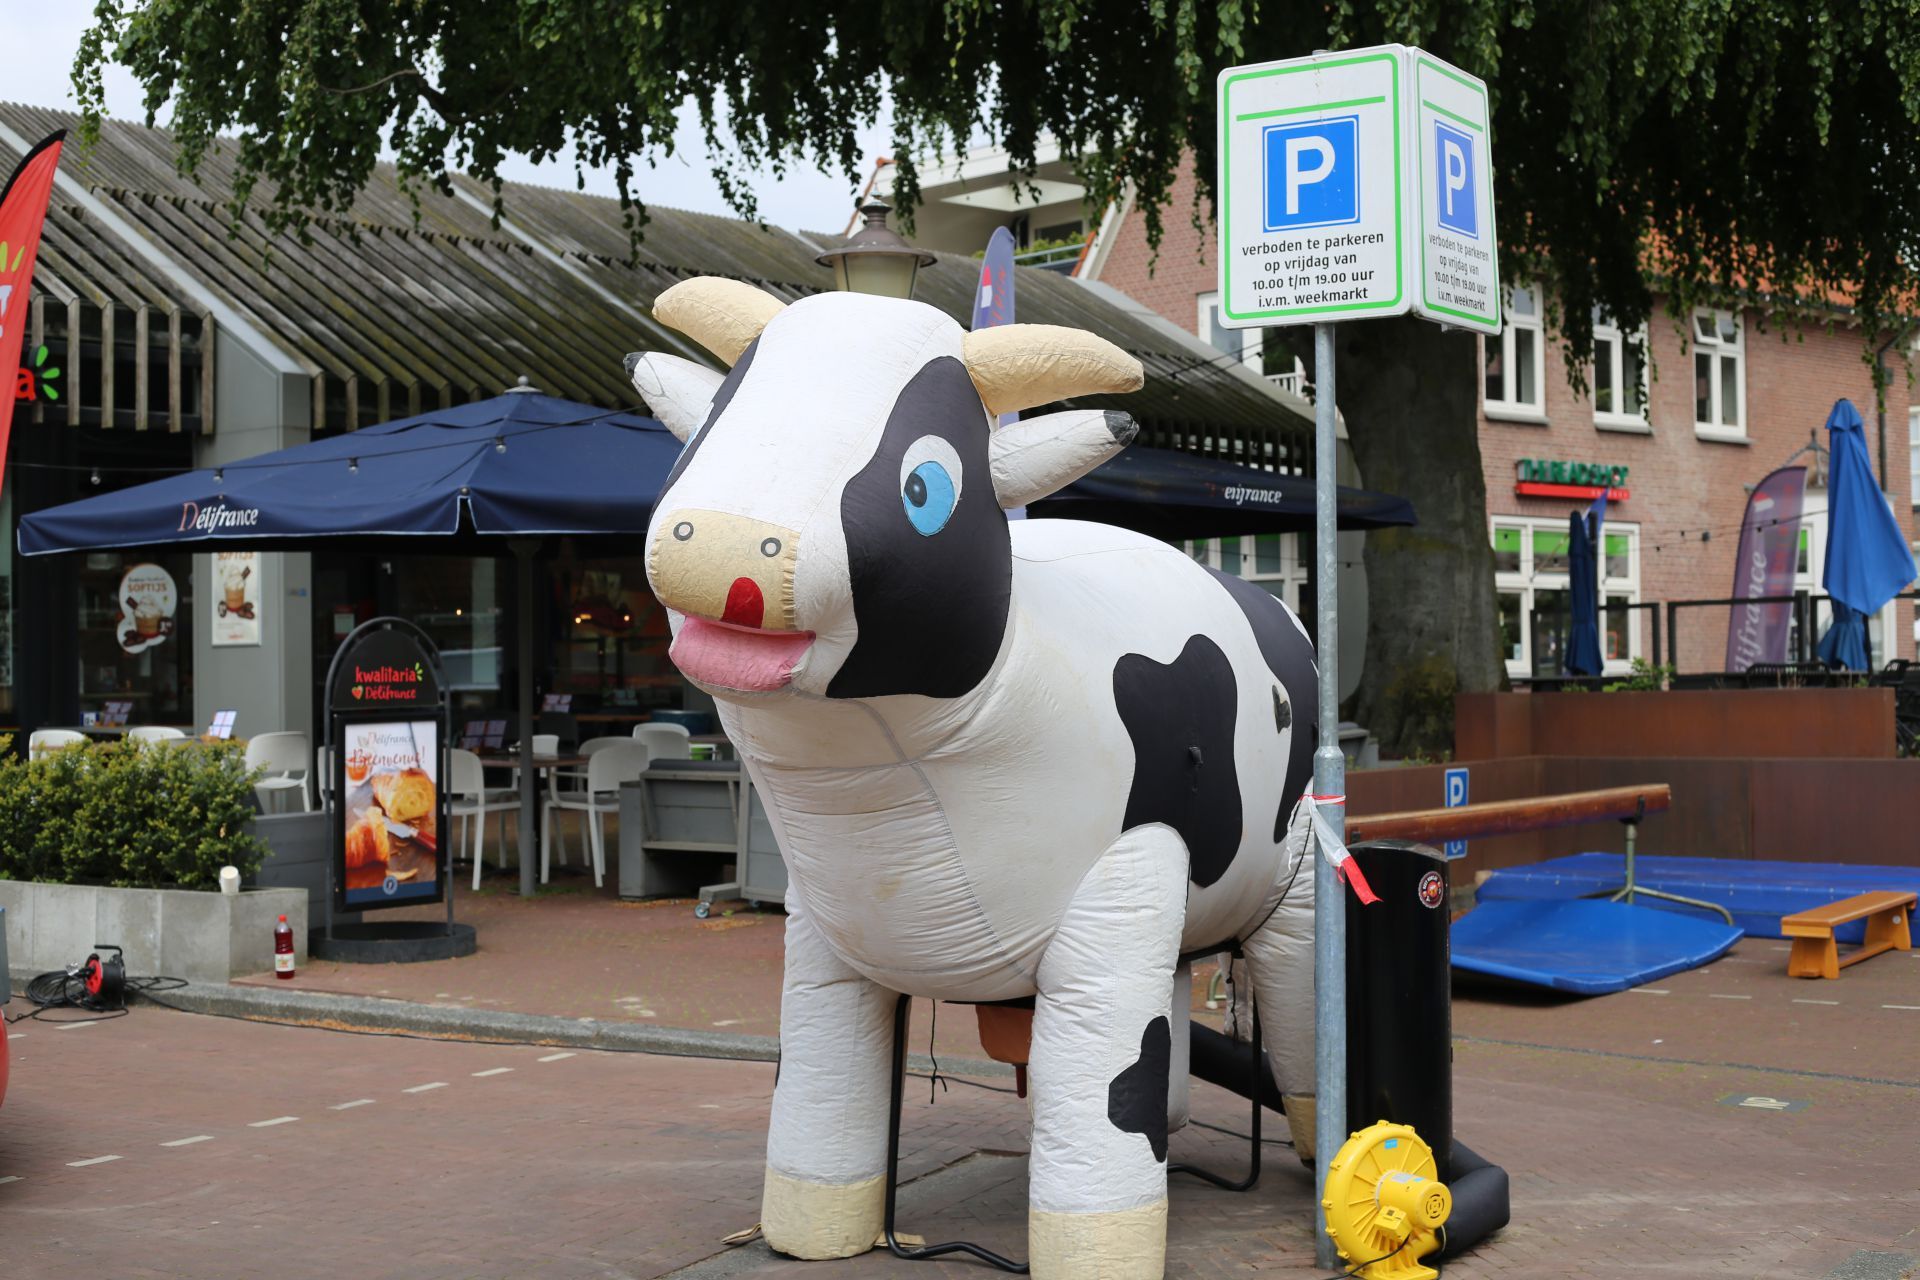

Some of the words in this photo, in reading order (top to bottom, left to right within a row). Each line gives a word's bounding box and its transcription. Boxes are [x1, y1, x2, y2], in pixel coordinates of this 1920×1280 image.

[1286, 136, 1335, 215] P
[1444, 139, 1466, 216] P
[1242, 240, 1302, 255] verboden
[1307, 238, 1320, 250] te
[1325, 233, 1384, 251] parkeren
[1429, 234, 1455, 251] verboden
[1457, 242, 1463, 254] te
[1465, 245, 1489, 262] parkeren
[1264, 261, 1280, 274] op
[1284, 255, 1329, 271] vrijdag
[1334, 254, 1357, 265] van
[1439, 255, 1447, 269] op
[1448, 256, 1468, 276] vrijdag
[1469, 264, 1479, 275] van
[1253, 278, 1284, 290] 10.00
[1288, 274, 1310, 290] t/m
[1315, 272, 1346, 284] 19.00
[1352, 270, 1375, 281] uur
[1435, 271, 1450, 284] 10.00
[1450, 274, 1461, 289] t/m
[1462, 279, 1476, 293] 19.00
[1477, 285, 1487, 295] uur
[1258, 295, 1290, 308] i.v.m.
[1294, 287, 1368, 305] weekmarkt
[1454, 293, 1485, 312] weekmarkt
[177, 502, 258, 533] Délifrance
[355, 665, 416, 683] kwalitaria
